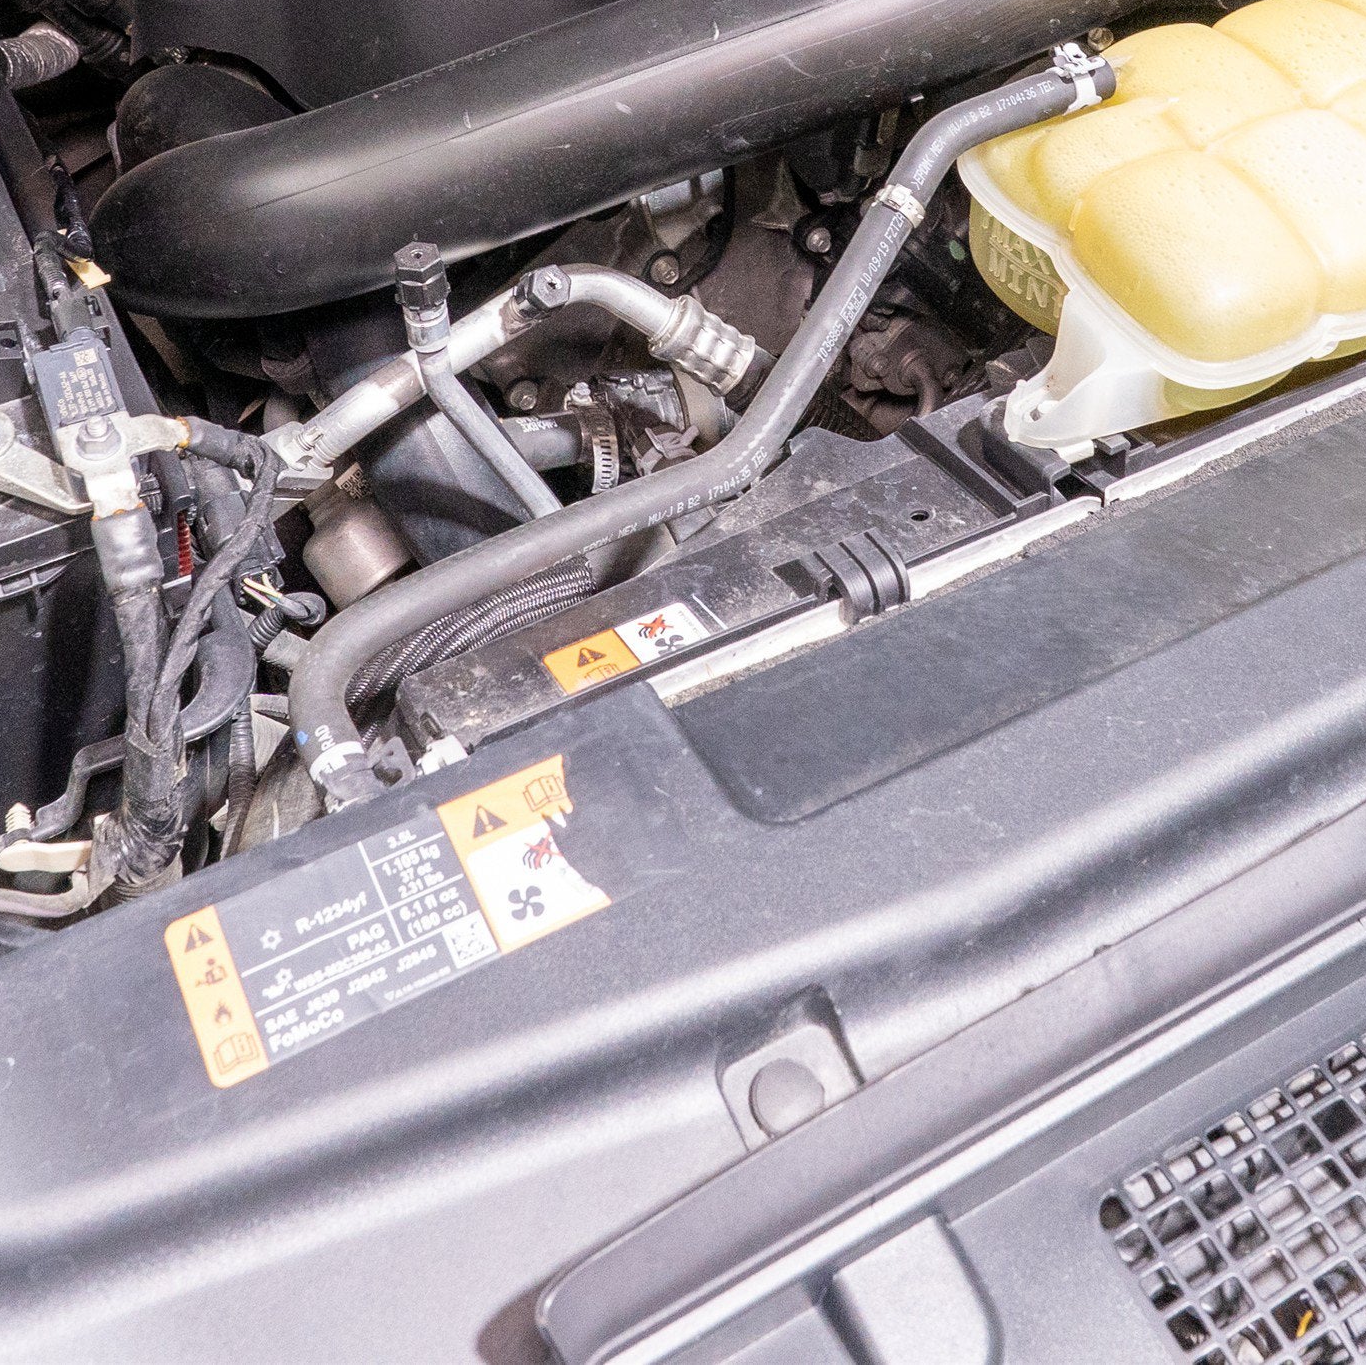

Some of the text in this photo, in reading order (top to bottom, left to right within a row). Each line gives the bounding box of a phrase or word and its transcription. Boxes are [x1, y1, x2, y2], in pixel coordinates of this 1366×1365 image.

[842, 288, 867, 325] FoMoCo
[860, 243, 889, 287] 10/09/19
[932, 138, 947, 159] MEX
[995, 85, 1038, 114] 17:04:36
[1037, 79, 1056, 96] TEC
[988, 247, 1051, 309] MIN
[687, 495, 701, 511] B2
[707, 466, 752, 501] 17:04:35
[751, 446, 769, 471] TEC
[419, 844, 440, 859] kg
[295, 892, 366, 934] R-1234yf
[400, 887, 459, 920] 6.1 fl oz
[443, 900, 467, 920] cc)
[347, 923, 385, 950] PAG
[265, 1009, 299, 1033] SAE
[269, 1009, 344, 1052] FoMoCo
